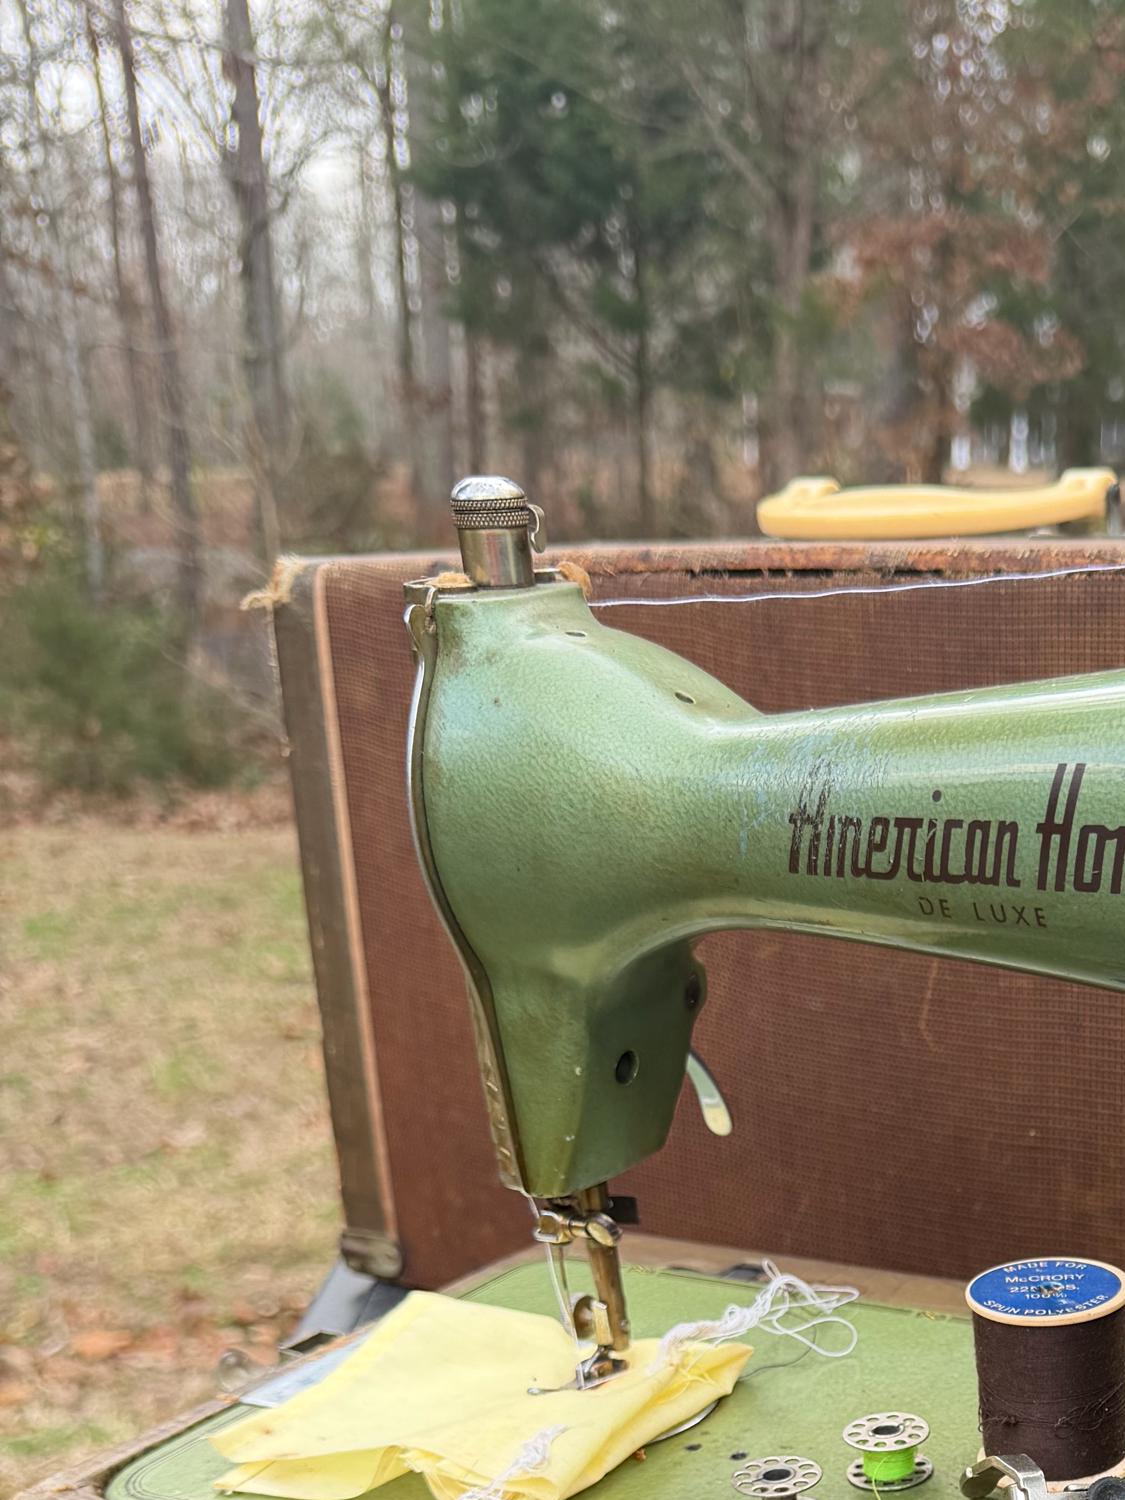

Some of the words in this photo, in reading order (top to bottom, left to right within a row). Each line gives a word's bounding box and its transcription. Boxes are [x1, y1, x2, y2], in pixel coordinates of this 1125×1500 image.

[787, 758, 1021, 888] American
[918, 897, 952, 918] DE
[973, 902, 1048, 928] LUXE
[1003, 1261, 1048, 1273] MADE
[1055, 1261, 1088, 1270] FOR
[1005, 1273, 1085, 1284] McCRORY
[983, 1299, 1021, 1315] SPUN
[1023, 1294, 1109, 1316] POLYESTER
